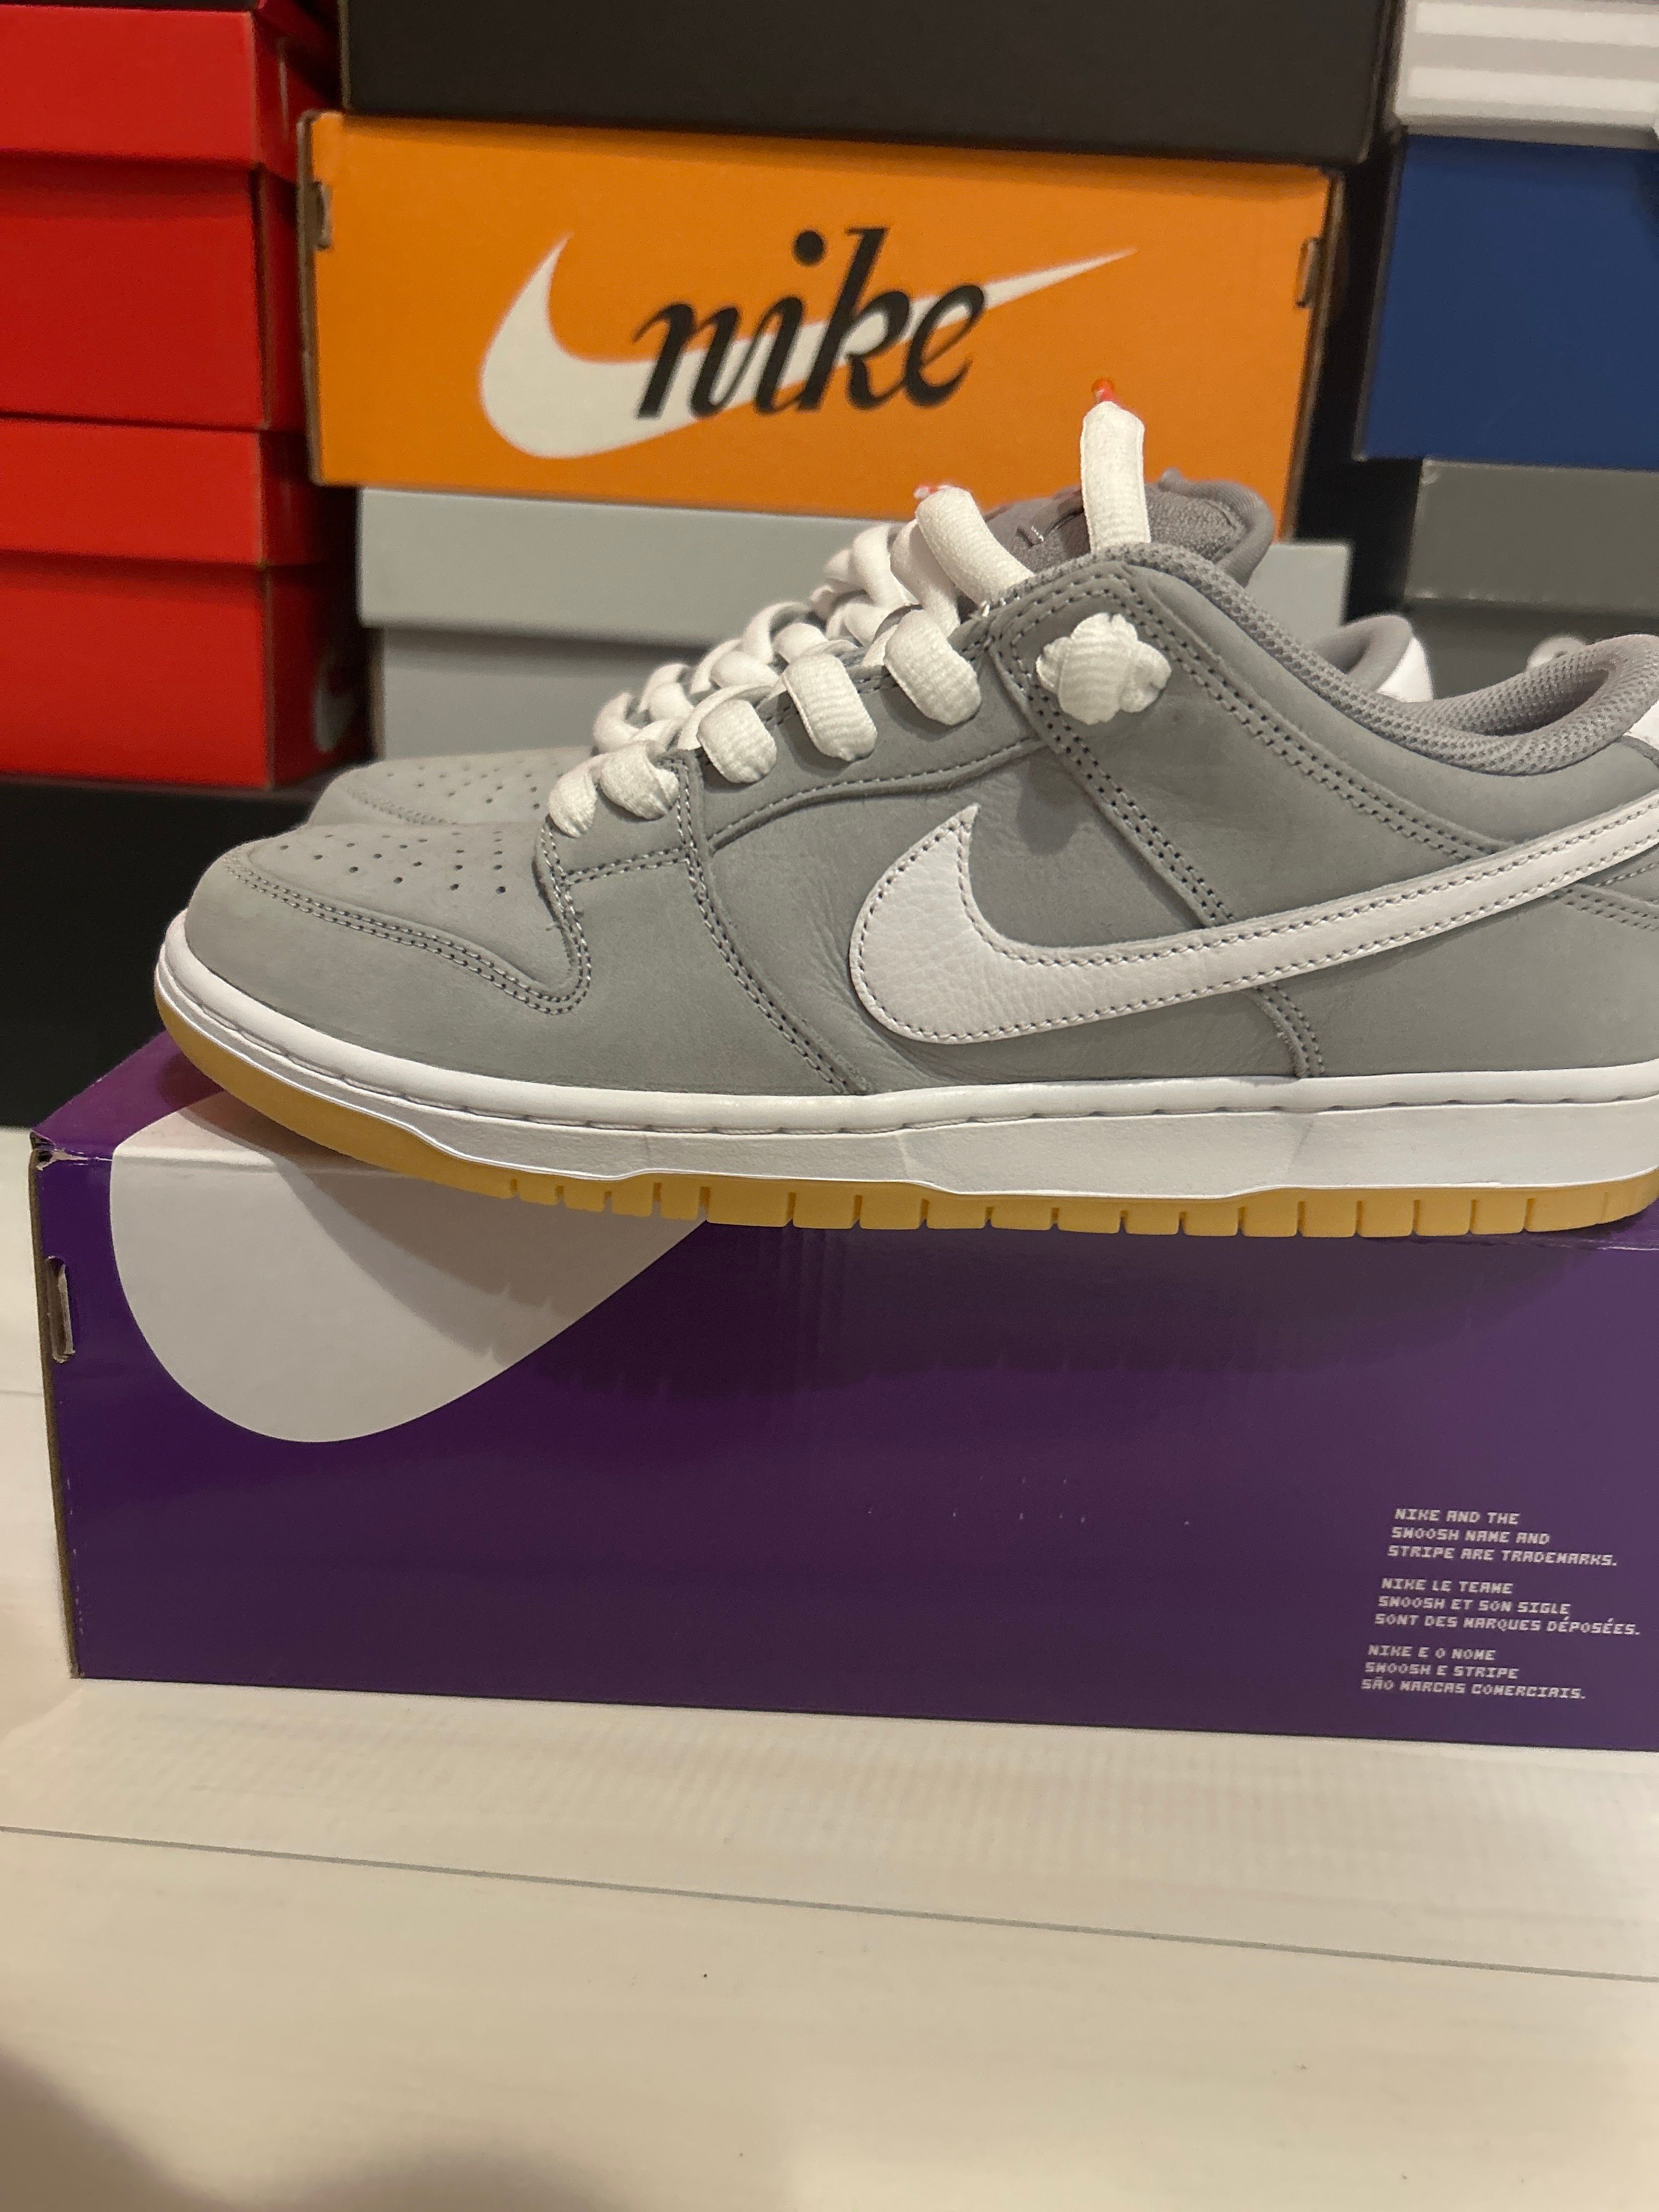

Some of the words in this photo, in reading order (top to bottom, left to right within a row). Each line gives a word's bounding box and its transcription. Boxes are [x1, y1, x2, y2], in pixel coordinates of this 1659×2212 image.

[633, 227, 986, 418] nike
[1395, 1508, 1441, 1521] NIKE
[1446, 1510, 1481, 1523] AND
[1487, 1511, 1521, 1525] THE
[1391, 1527, 1459, 1541] SWOOSH
[1464, 1530, 1510, 1543] NAME
[1515, 1532, 1550, 1545] AND
[1387, 1545, 1455, 1559] STRIPE
[1460, 1548, 1495, 1561] ARE
[1500, 1550, 1617, 1566] TRADEMARKS.
[1381, 1578, 1427, 1591] NIKE
[1431, 1580, 1453, 1592] LE
[1378, 1595, 1446, 1609] SWOOSH
[1449, 1598, 1474, 1611] ET
[1477, 1600, 1514, 1612] SON
[1516, 1601, 1571, 1615] SIGLE
[1374, 1613, 1419, 1626] SONT
[1424, 1615, 1458, 1628] DES
[1463, 1617, 1542, 1632] MARQUES
[1546, 1616, 1640, 1635] DÉPOSÉES.
[1368, 1644, 1413, 1657] NIKE
[1418, 1647, 1430, 1658] E
[1435, 1647, 1447, 1659] O
[1451, 1648, 1497, 1661] NOME
[1364, 1662, 1431, 1675] SWOOSH
[1436, 1665, 1448, 1676] E
[1452, 1666, 1519, 1679] STRIPE
[1361, 1676, 1395, 1691] SÃO
[1399, 1680, 1466, 1694] MARCAS
[1471, 1684, 1586, 1700] COMERCIAIS.
